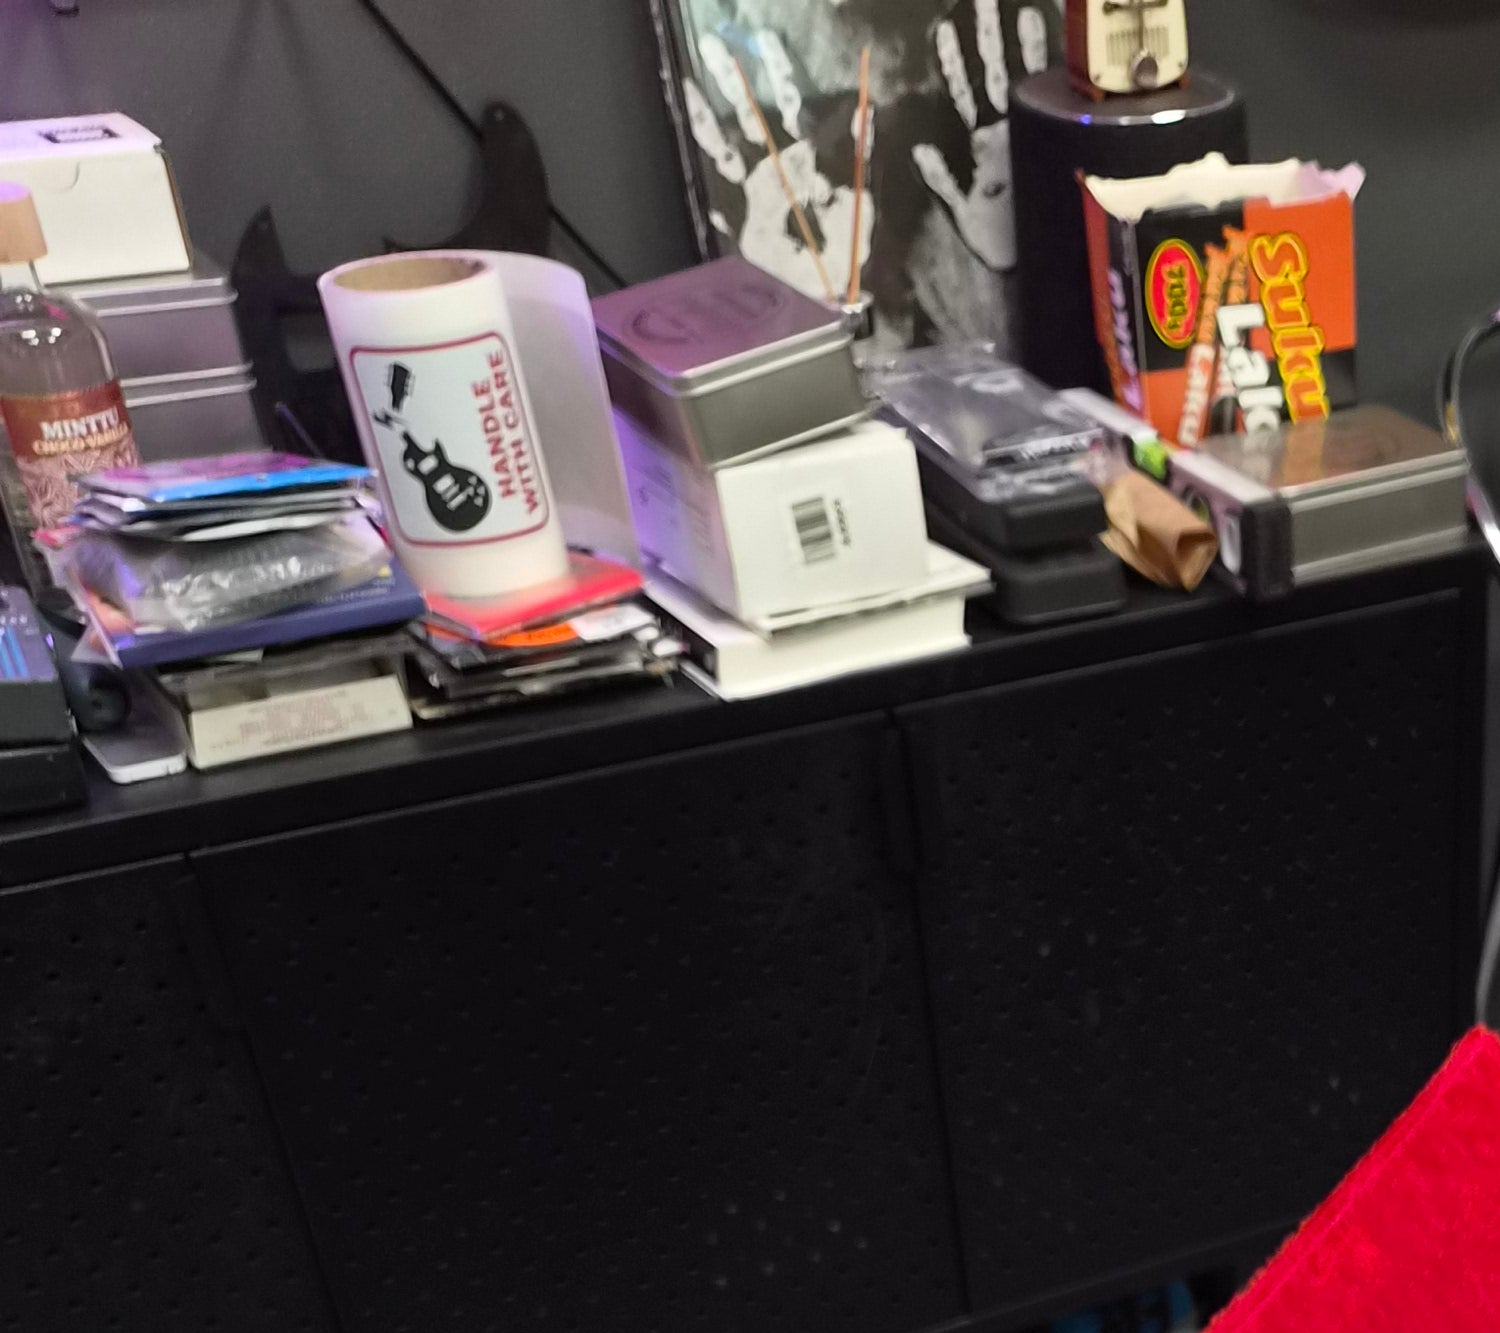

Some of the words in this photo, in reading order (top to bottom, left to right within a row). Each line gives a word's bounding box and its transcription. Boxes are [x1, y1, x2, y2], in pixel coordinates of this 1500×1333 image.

[1216, 302, 1284, 433] Lak
[1248, 232, 1331, 424] Suku
[40, 404, 119, 441] MINTTU
[471, 379, 515, 499] HANDLE
[487, 351, 519, 430] CARE
[510, 438, 538, 514] WITH
